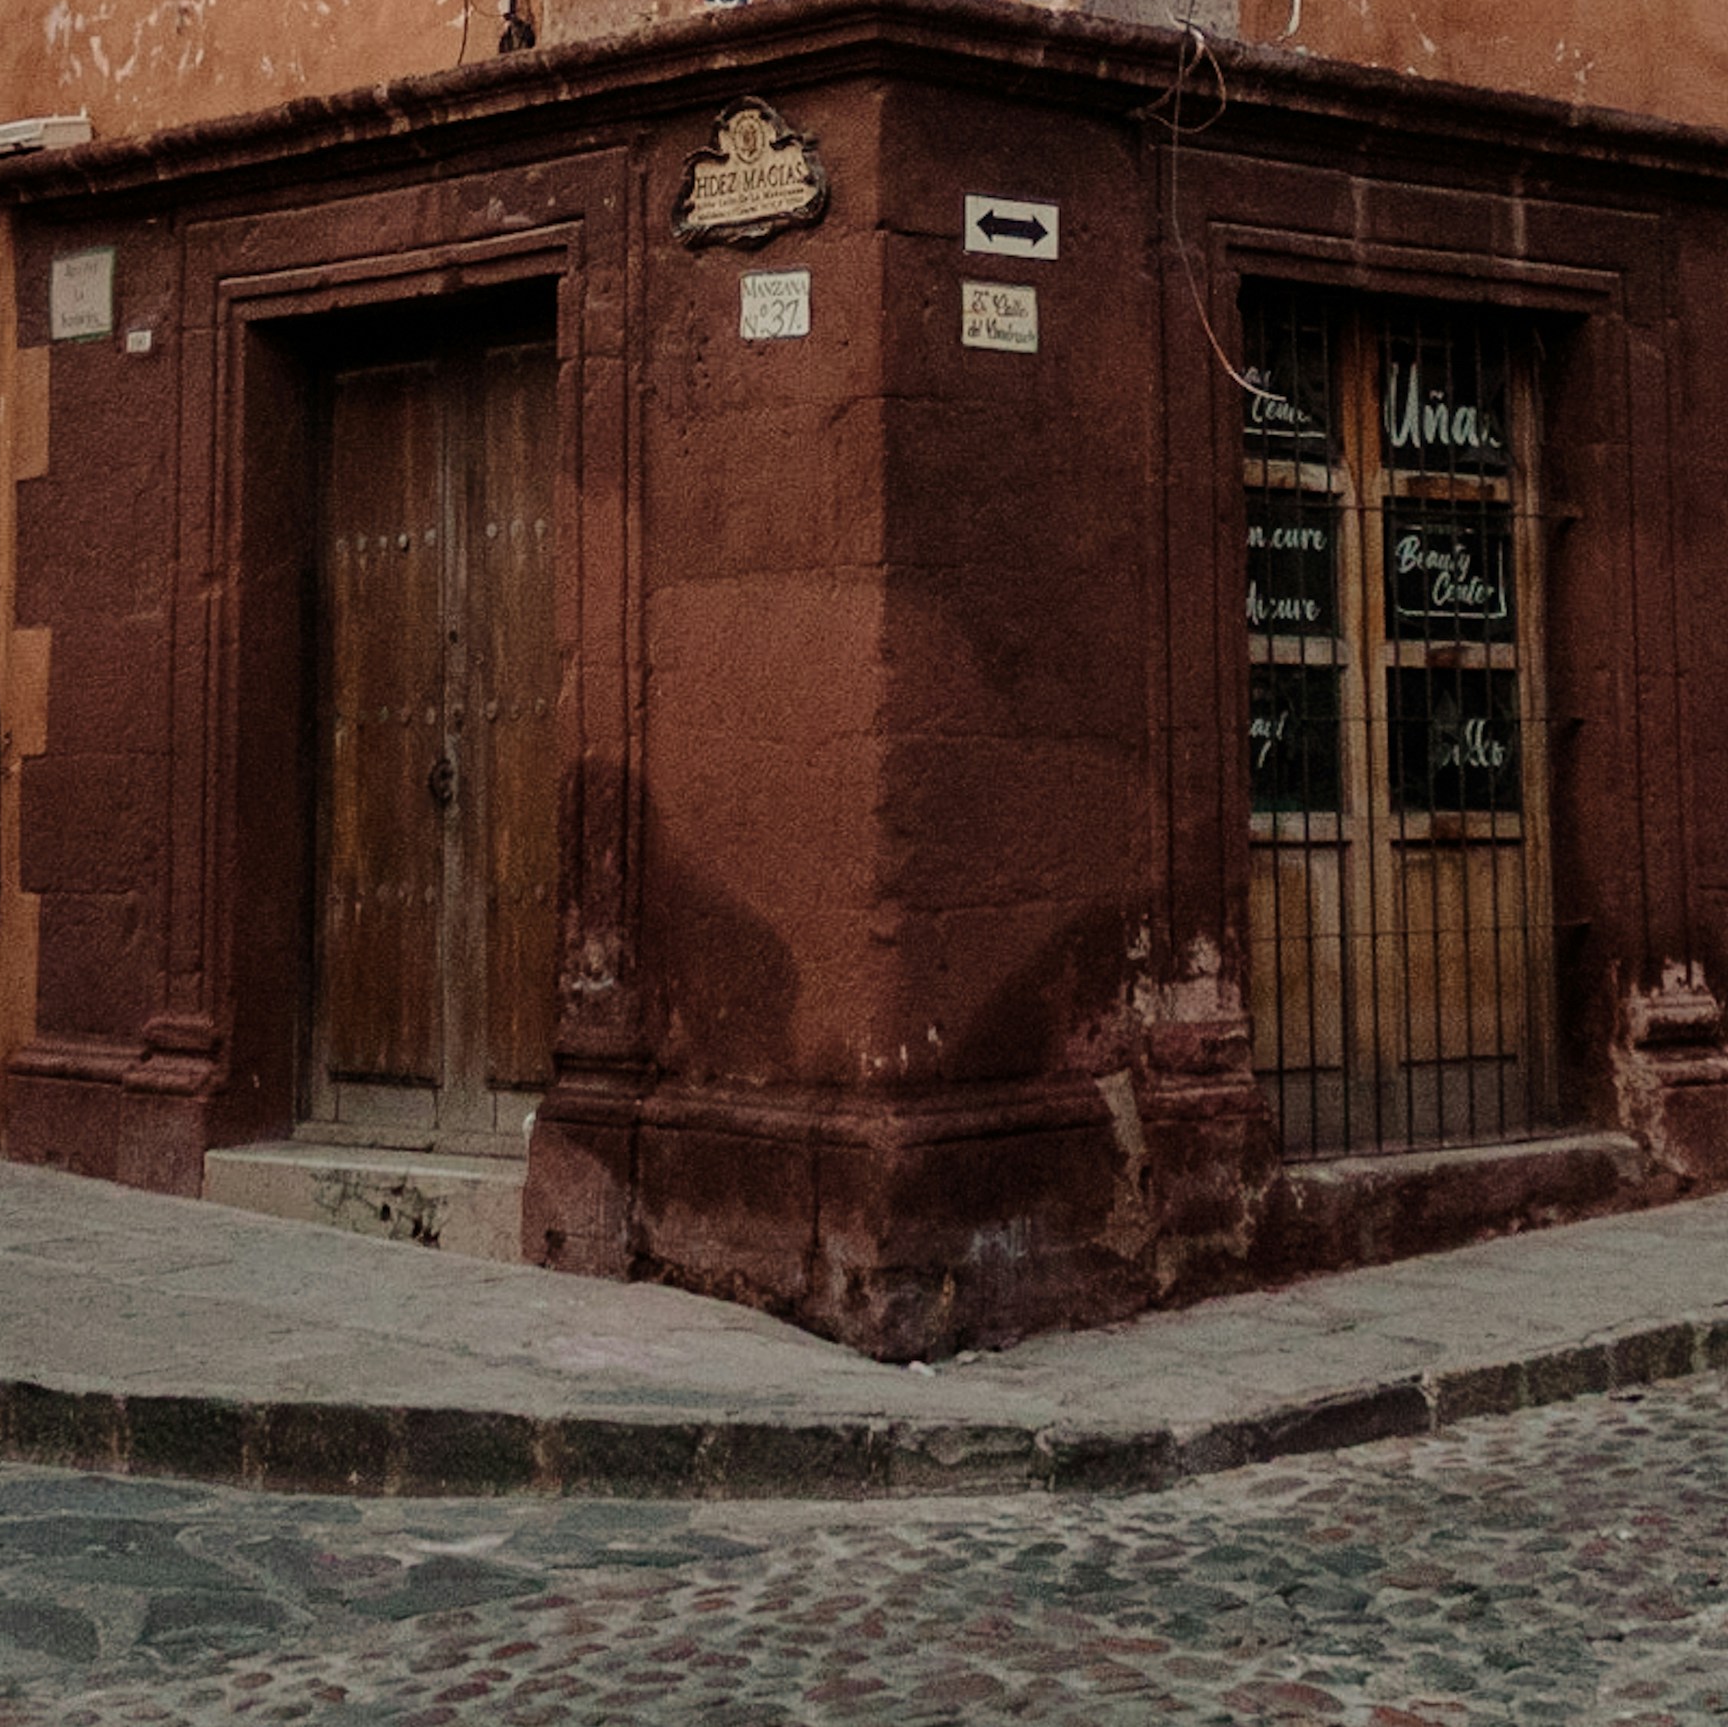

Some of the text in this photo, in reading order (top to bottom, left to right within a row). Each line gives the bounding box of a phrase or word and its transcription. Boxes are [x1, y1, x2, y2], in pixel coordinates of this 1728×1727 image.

[695, 172, 737, 199] HDEZ
[742, 161, 804, 192] MACIAS
[1395, 534, 1472, 583] Beauty
[1431, 571, 1495, 607] Center
